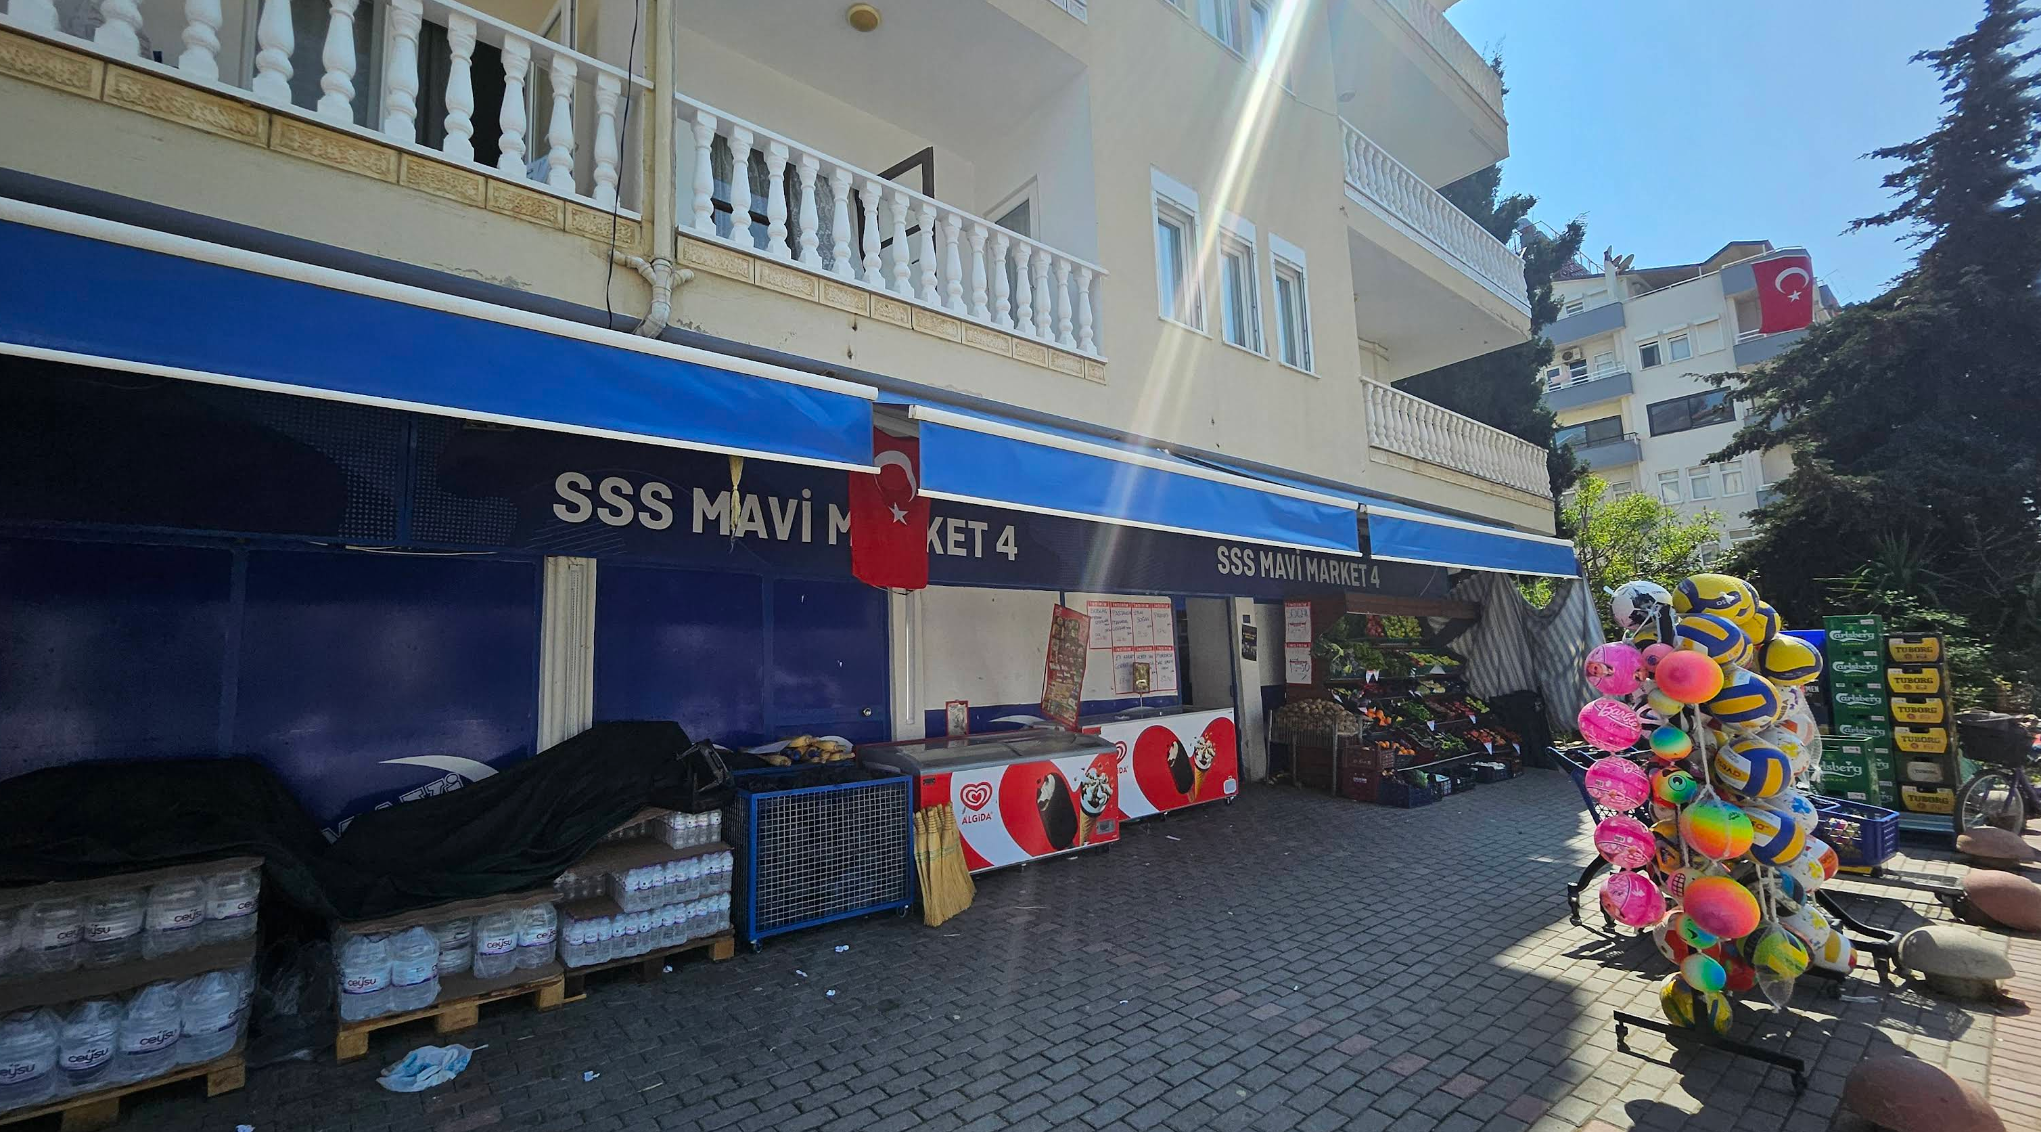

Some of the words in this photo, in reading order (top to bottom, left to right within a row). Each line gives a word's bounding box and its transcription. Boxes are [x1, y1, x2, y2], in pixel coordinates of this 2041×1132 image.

[553, 471, 673, 531] SSS
[828, 502, 988, 558] MKET
[996, 525, 1018, 561] 4
[1217, 545, 1256, 577] SSS
[1305, 557, 1367, 588] MARKET
[1370, 565, 1380, 588] 4
[1829, 630, 1875, 641] Carlsberg
[1832, 661, 1878, 673] Carlsberg
[1836, 693, 1882, 705] Carlsberg
[1599, 703, 1637, 729] Barbie
[1840, 725, 1886, 737] Carlsberg
[1901, 735, 1941, 744] TUBORG
